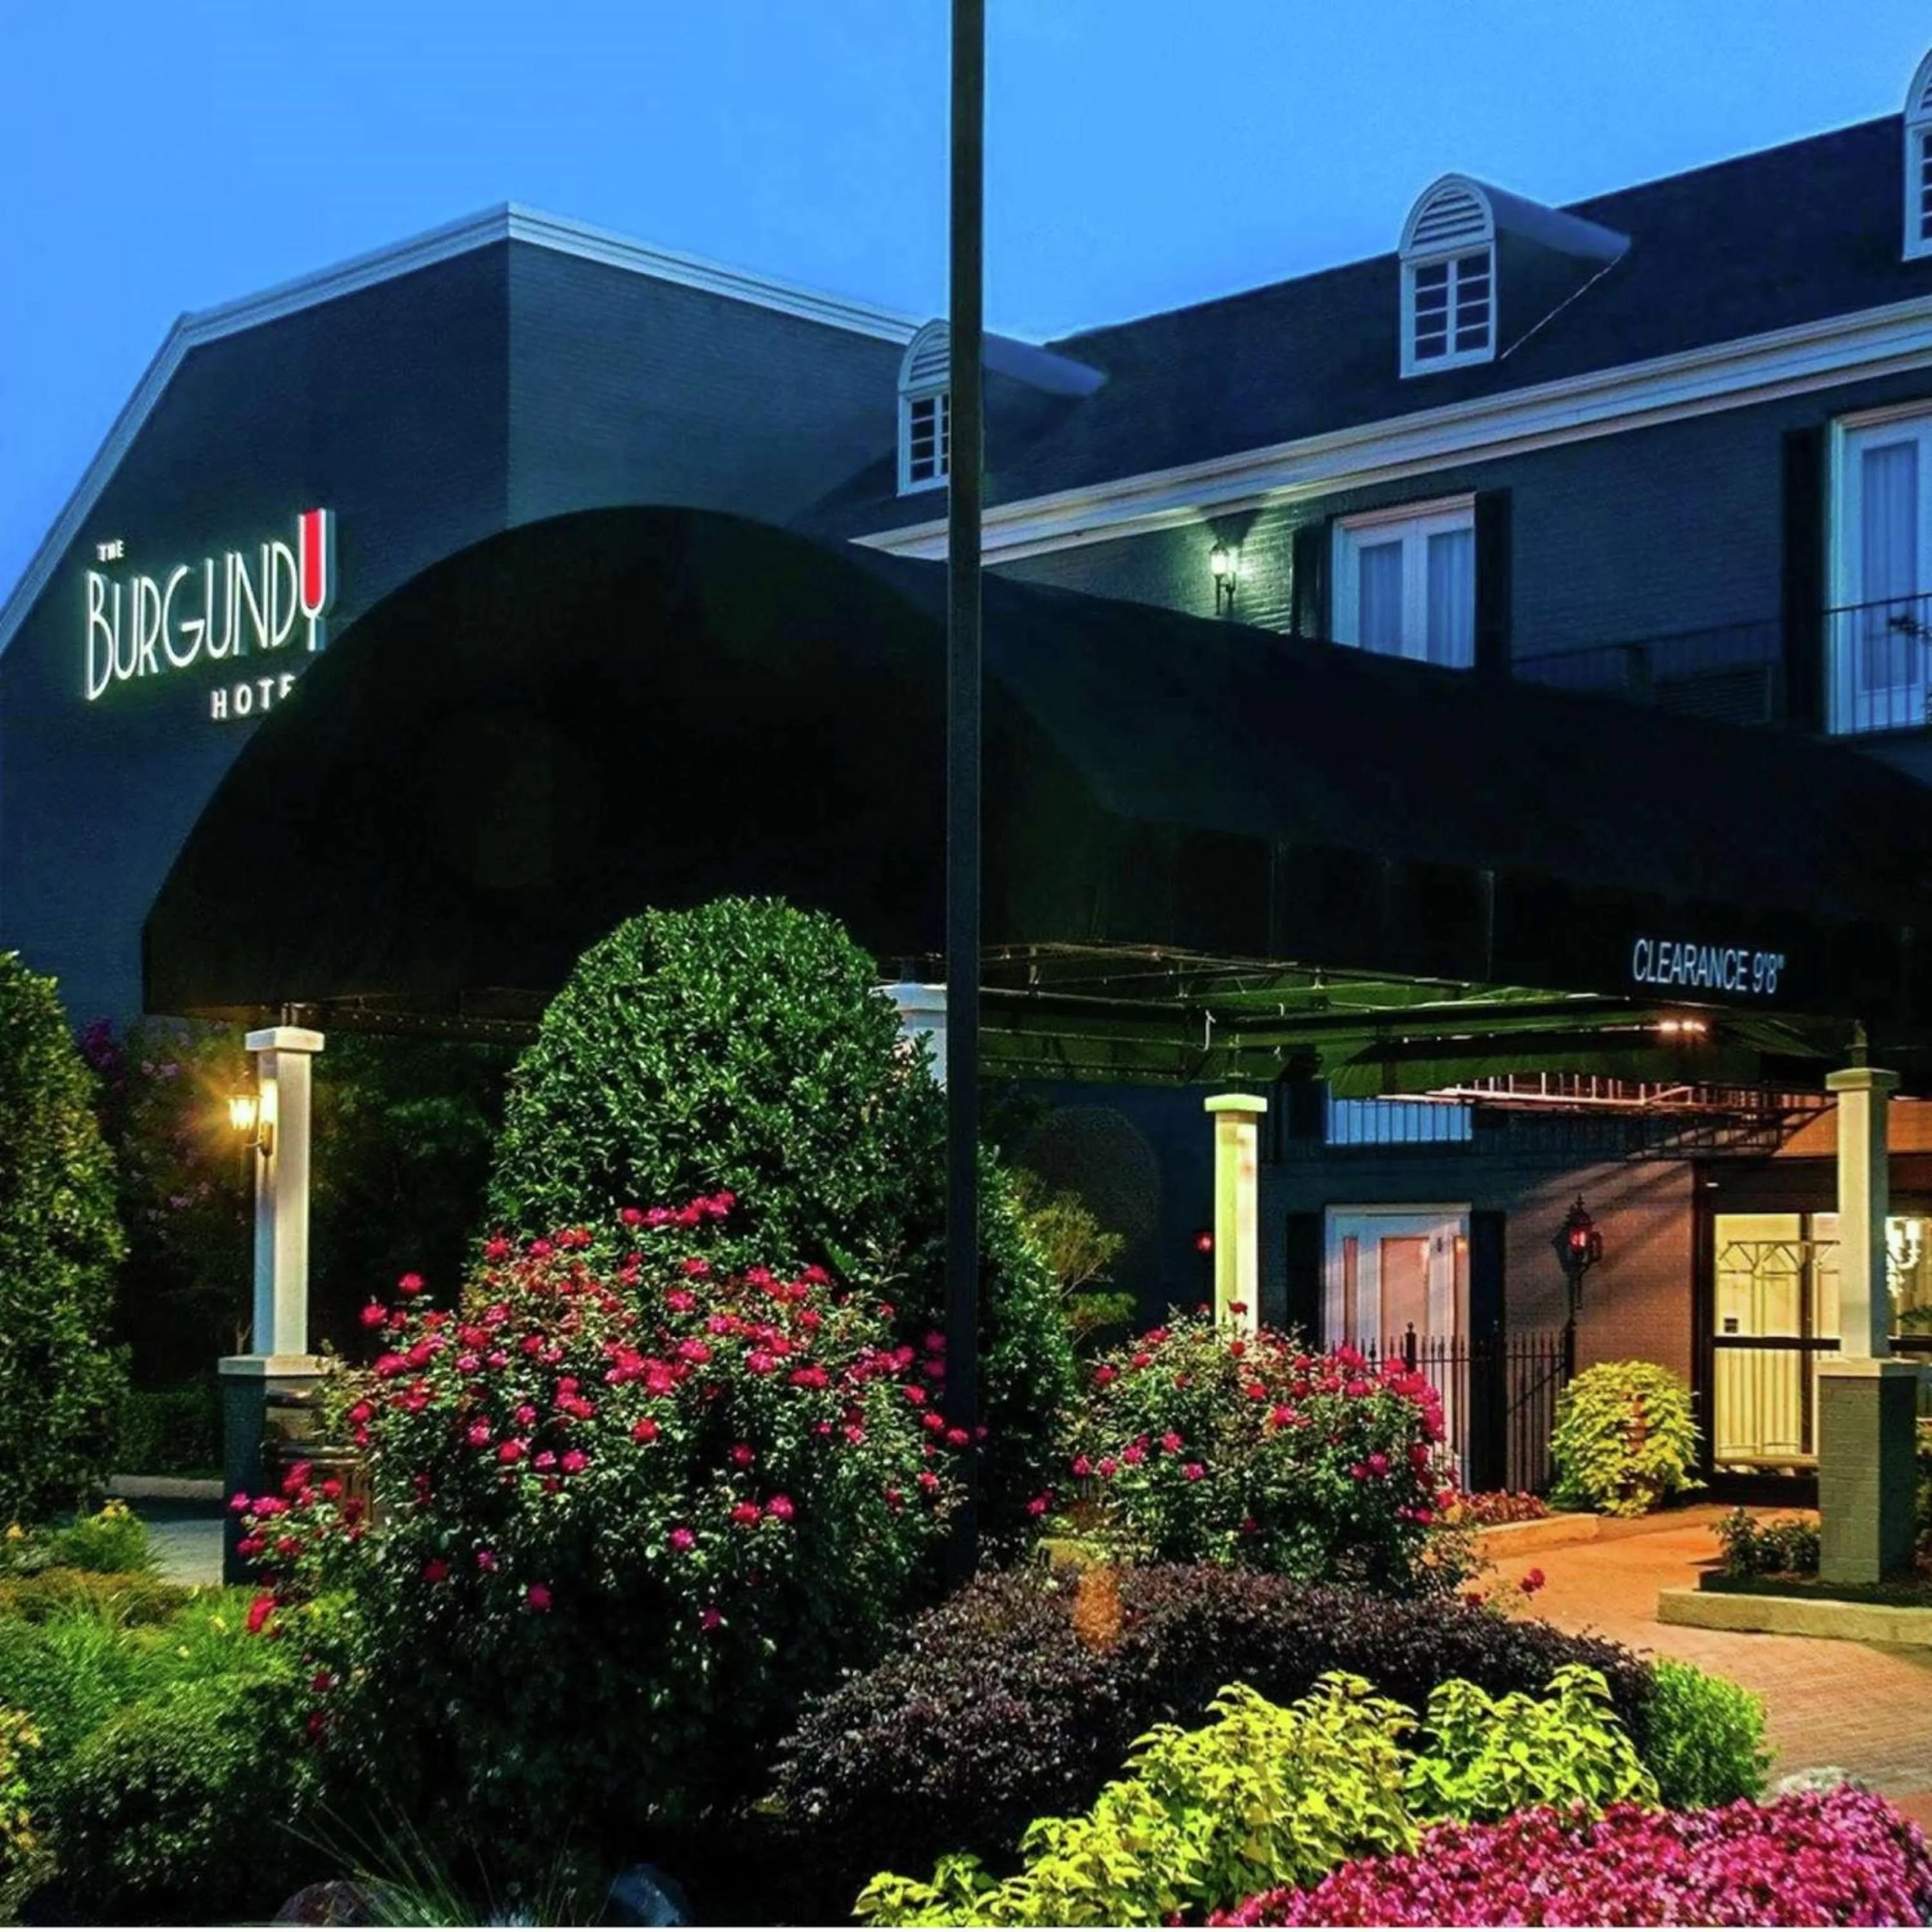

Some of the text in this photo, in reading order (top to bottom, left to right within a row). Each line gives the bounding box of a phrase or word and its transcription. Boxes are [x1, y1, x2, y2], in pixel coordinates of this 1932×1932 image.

[97, 540, 125, 561] THE
[85, 507, 327, 701] BURGUNDY
[211, 673, 296, 720] HOTE
[1633, 938, 1749, 991] CLEARANCE
